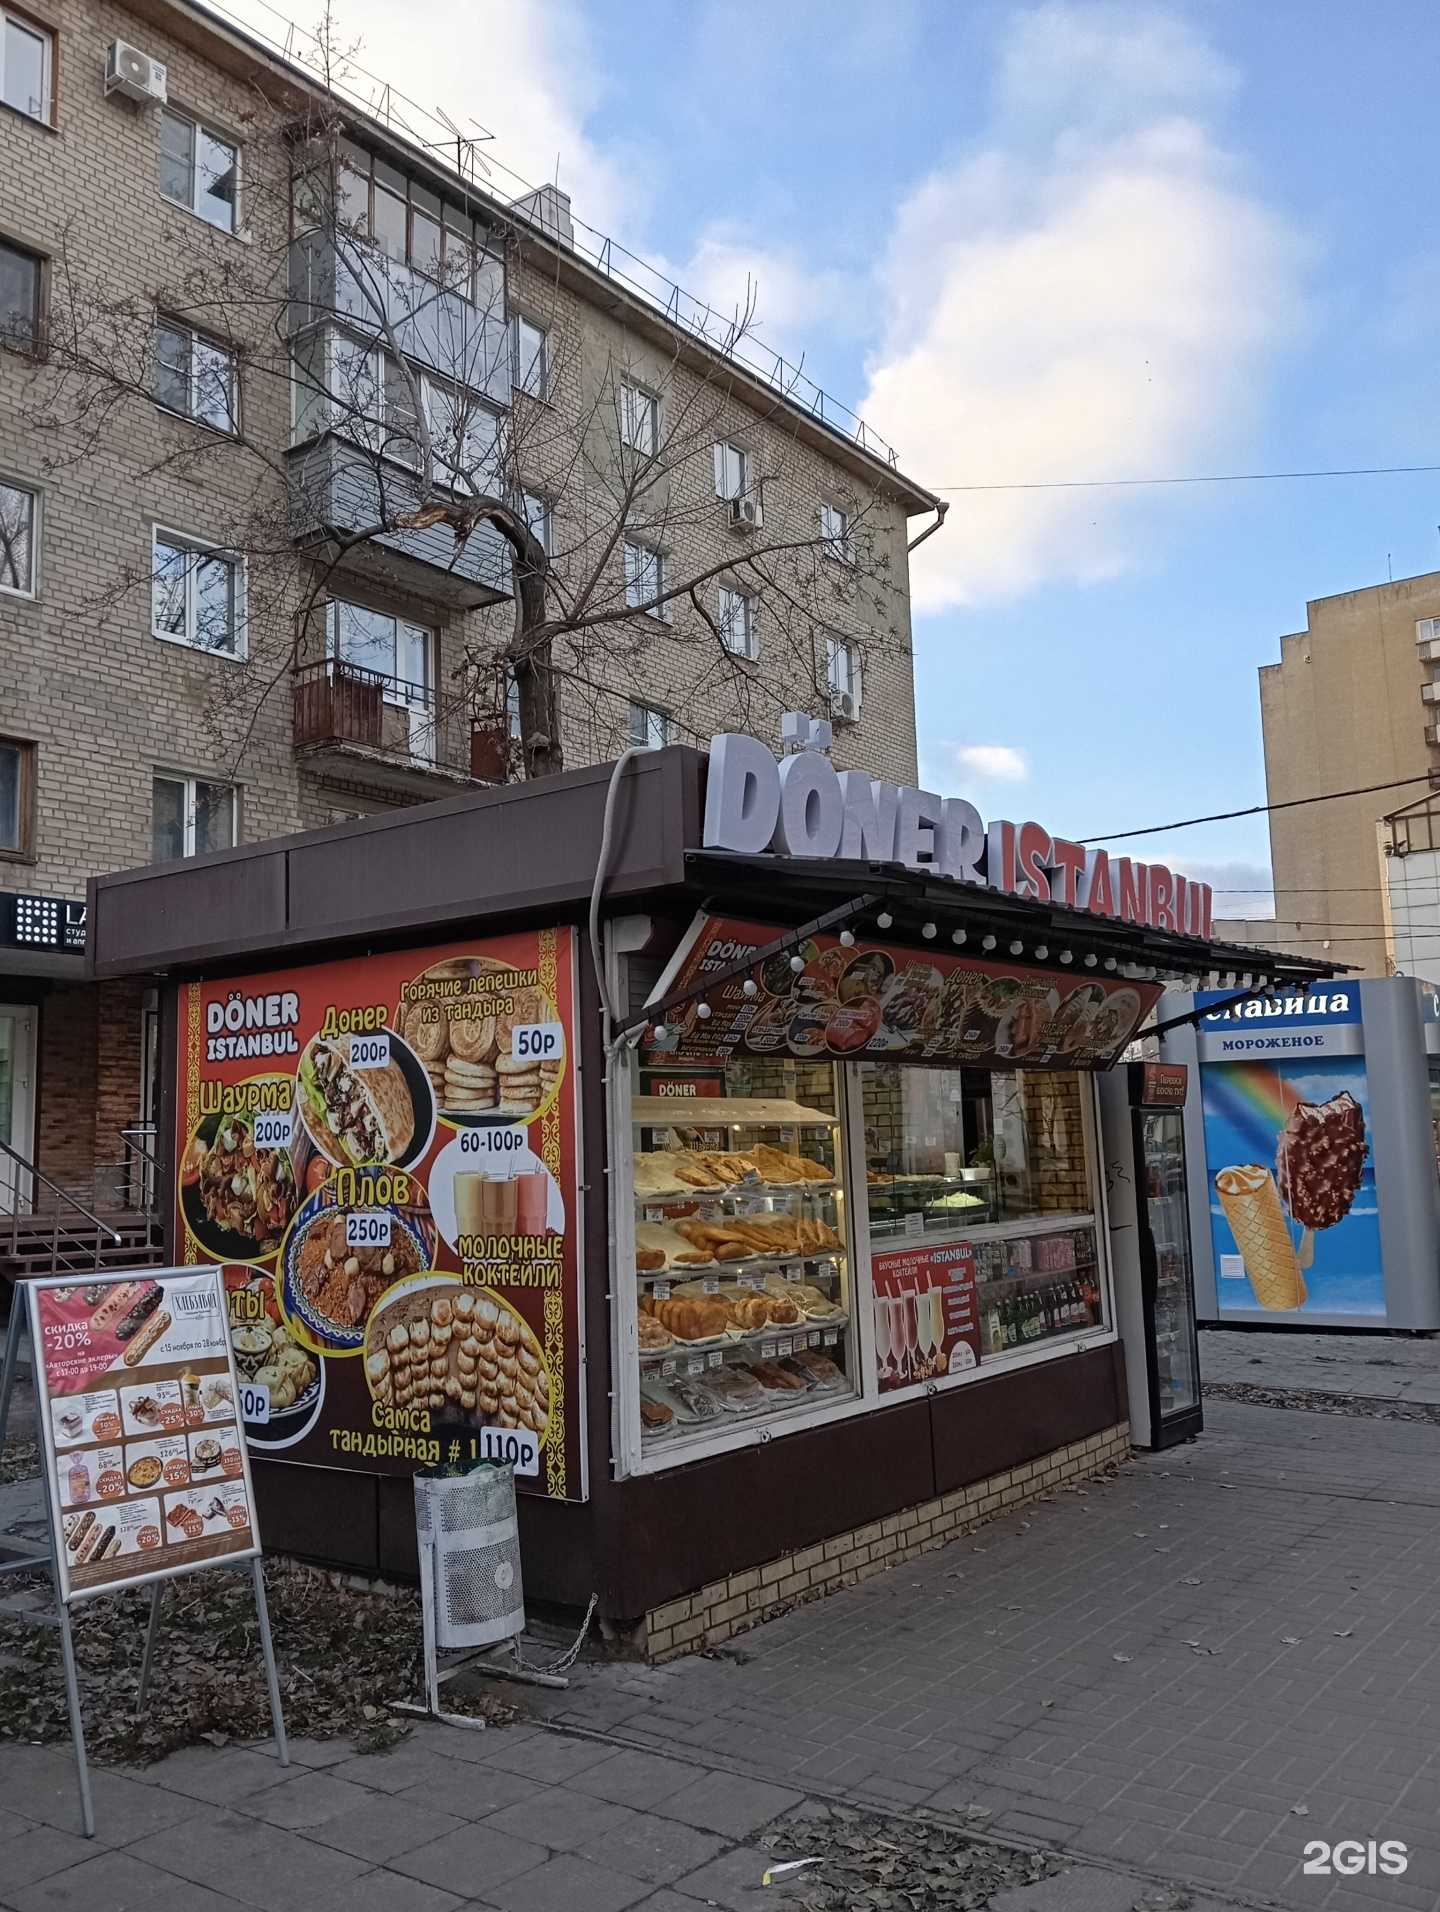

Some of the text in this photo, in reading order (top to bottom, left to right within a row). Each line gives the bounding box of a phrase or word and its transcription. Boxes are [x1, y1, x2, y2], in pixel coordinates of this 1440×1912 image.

[703, 712, 988, 885] DÖNER
[401, 968, 539, 1002] Горячие лепешки
[721, 984, 767, 1002] Шаума
[207, 992, 299, 1034] DÖNER
[320, 1005, 388, 1040] Донер
[421, 996, 515, 1024] из тандыра
[207, 1030, 299, 1061] ISTANBUL
[351, 1041, 387, 1063] 200р
[518, 1030, 555, 1055] 50р
[1222, 1035, 1325, 1051] МОРОЖЕНОЕ
[200, 1081, 292, 1115] Шаурма
[658, 1079, 697, 1097] DÖNER
[255, 1120, 291, 1142] 200р
[460, 1130, 524, 1153] 60-100р
[336, 1166, 410, 1208] Плов
[348, 1218, 389, 1241] 250р
[458, 1234, 564, 1259] МОЛОЧНЫЕ
[463, 1260, 562, 1287] КОКТЕЙЛИ
[46, 1331, 92, 1351] -20%
[371, 1400, 432, 1433] Самса
[329, 1429, 441, 1462] тандырная
